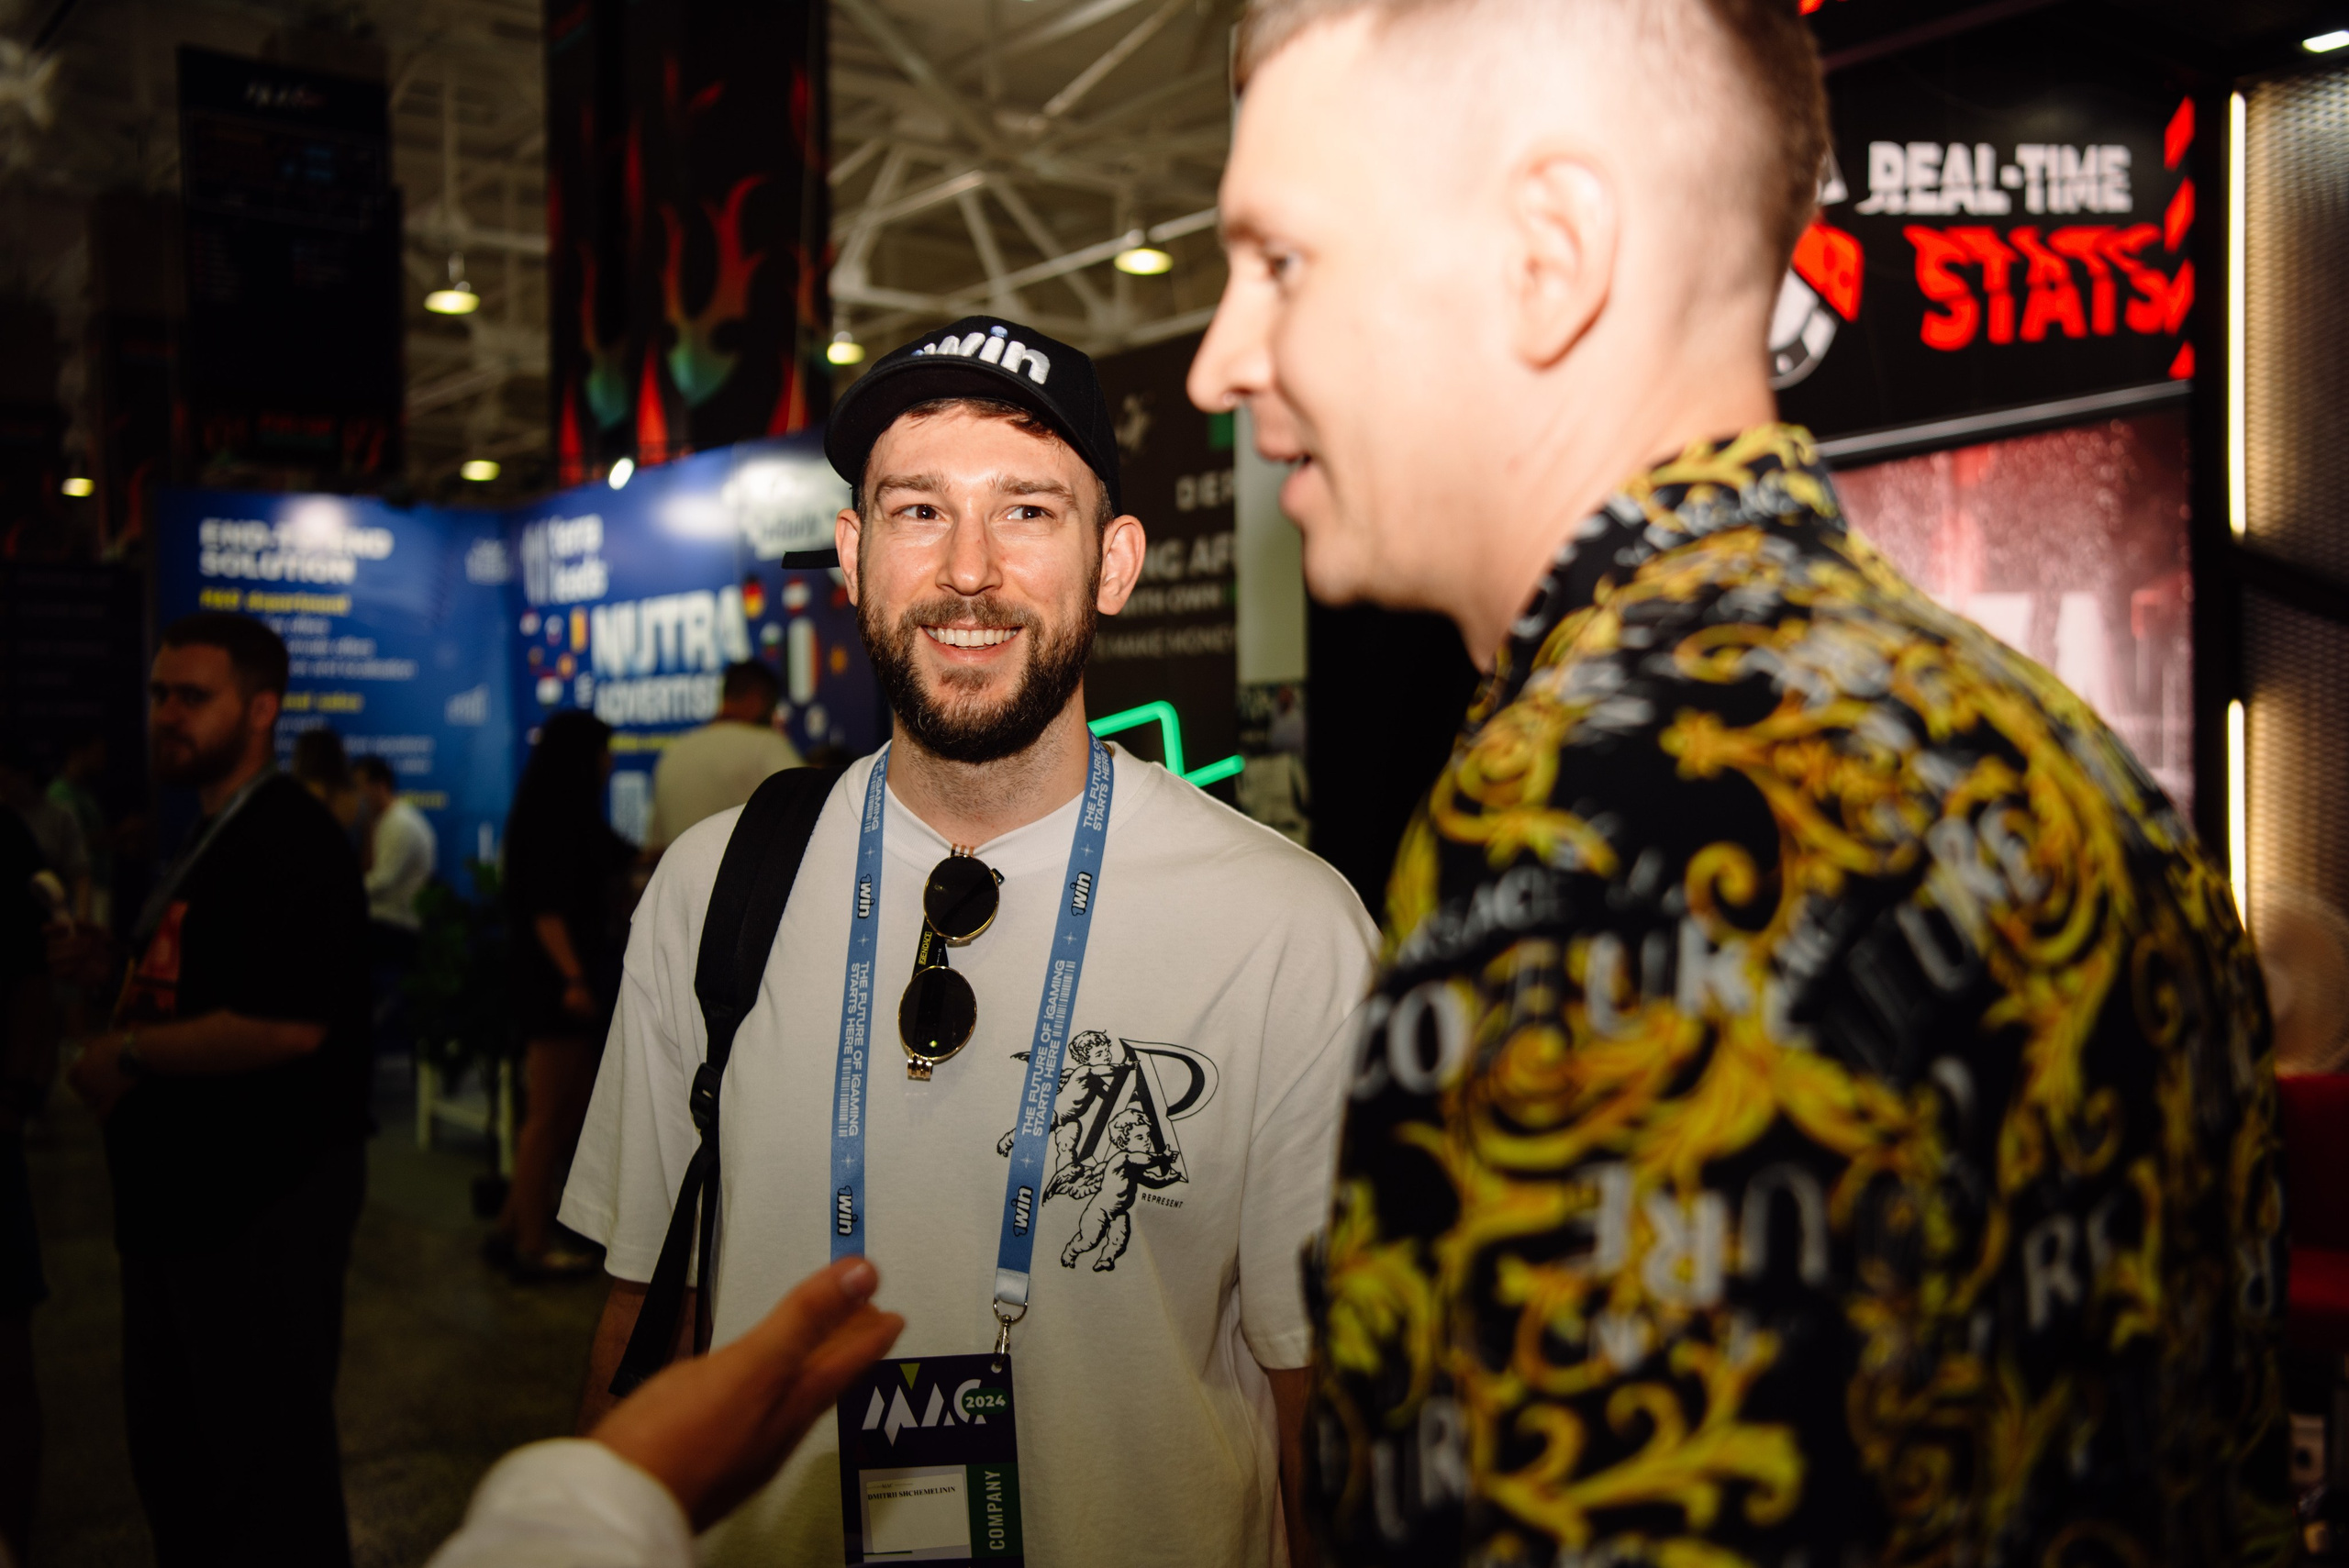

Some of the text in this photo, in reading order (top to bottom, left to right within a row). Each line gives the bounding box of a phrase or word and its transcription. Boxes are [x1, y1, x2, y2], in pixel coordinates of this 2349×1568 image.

[1903, 224, 2168, 350] STATS
[198, 550, 356, 584] SOLUTION
[590, 585, 751, 678] NUTRA
[1083, 802, 1097, 828] THE
[1089, 756, 1103, 799] FUTURE
[1092, 750, 1111, 832] STARTS HERE
[843, 962, 861, 1055] STARTS HERE
[847, 961, 869, 1137] THE FUTURE OF iGAMING
[1022, 960, 1065, 1136] THE FUTURE OF iGAMING
[1033, 1039, 1061, 1138] STARTS HERE
[1141, 1192, 1184, 1208] REPRESENT
[964, 1395, 1007, 1408] 2024
[985, 1470, 1006, 1551] COMPANY
